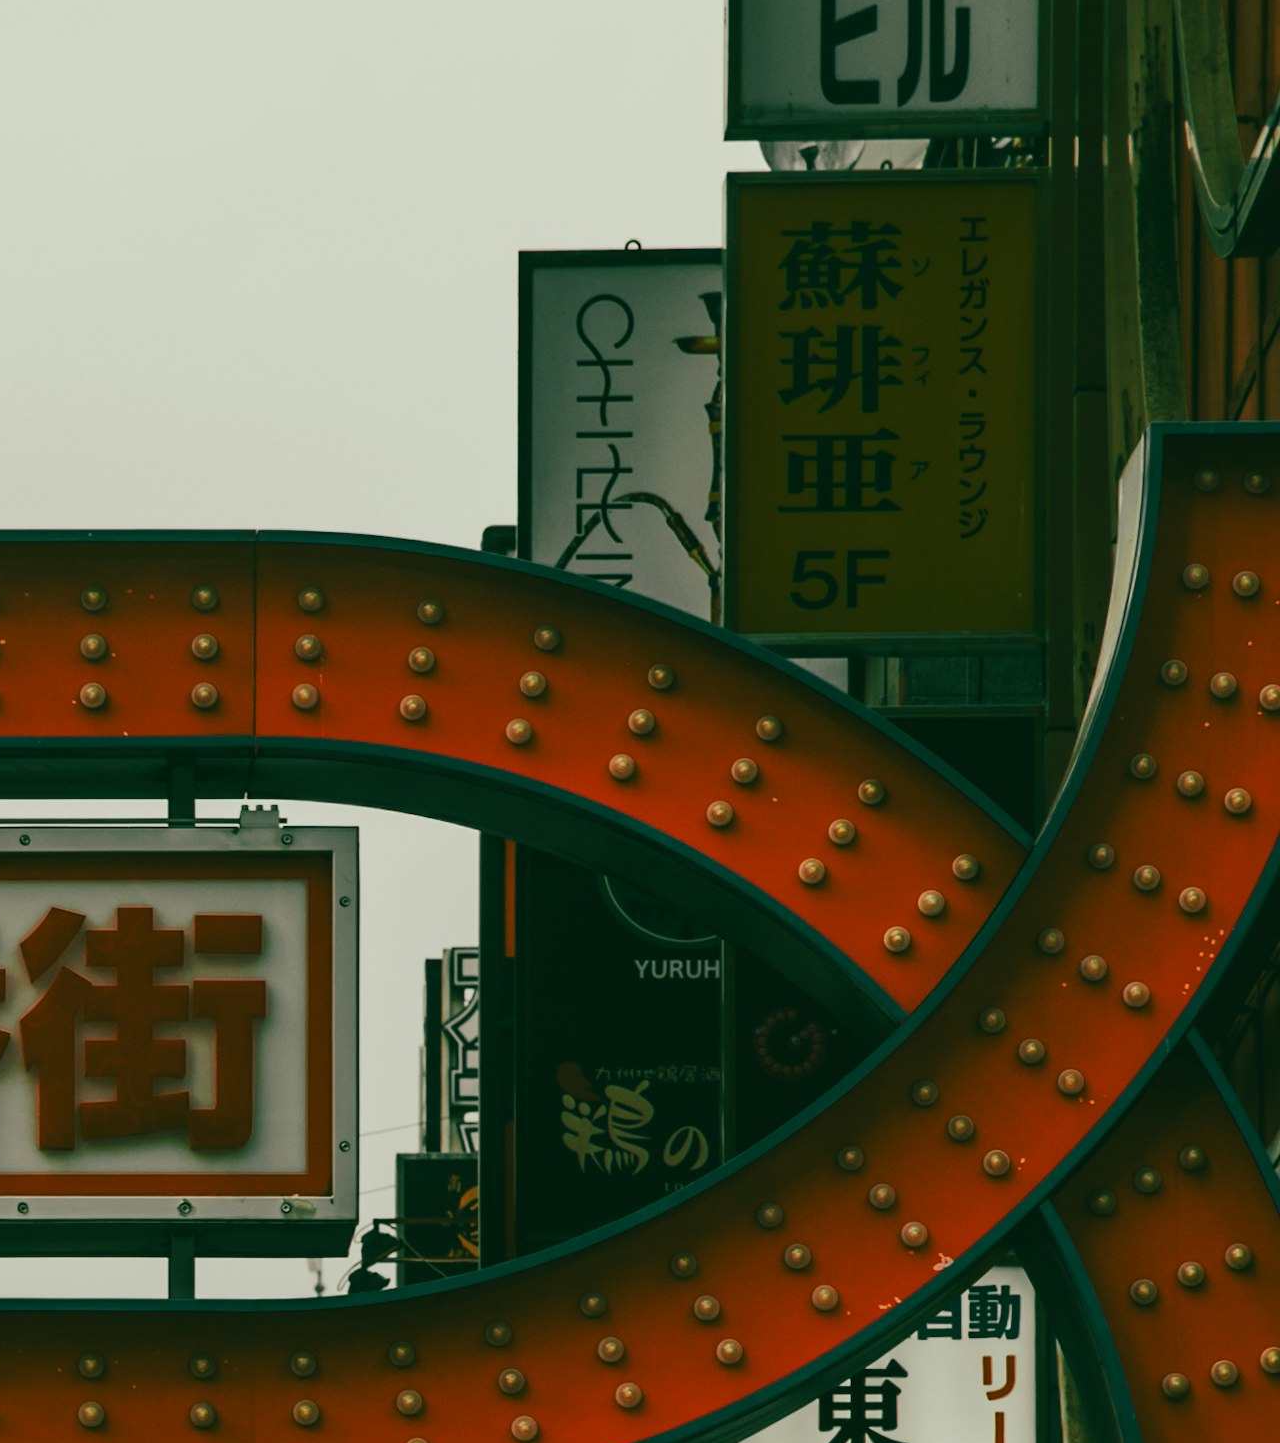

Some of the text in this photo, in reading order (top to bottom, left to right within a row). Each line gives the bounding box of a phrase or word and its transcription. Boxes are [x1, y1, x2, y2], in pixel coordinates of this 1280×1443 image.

[958, 217, 990, 540] エレガンス・ラウンジ
[789, 550, 890, 610] 5F
